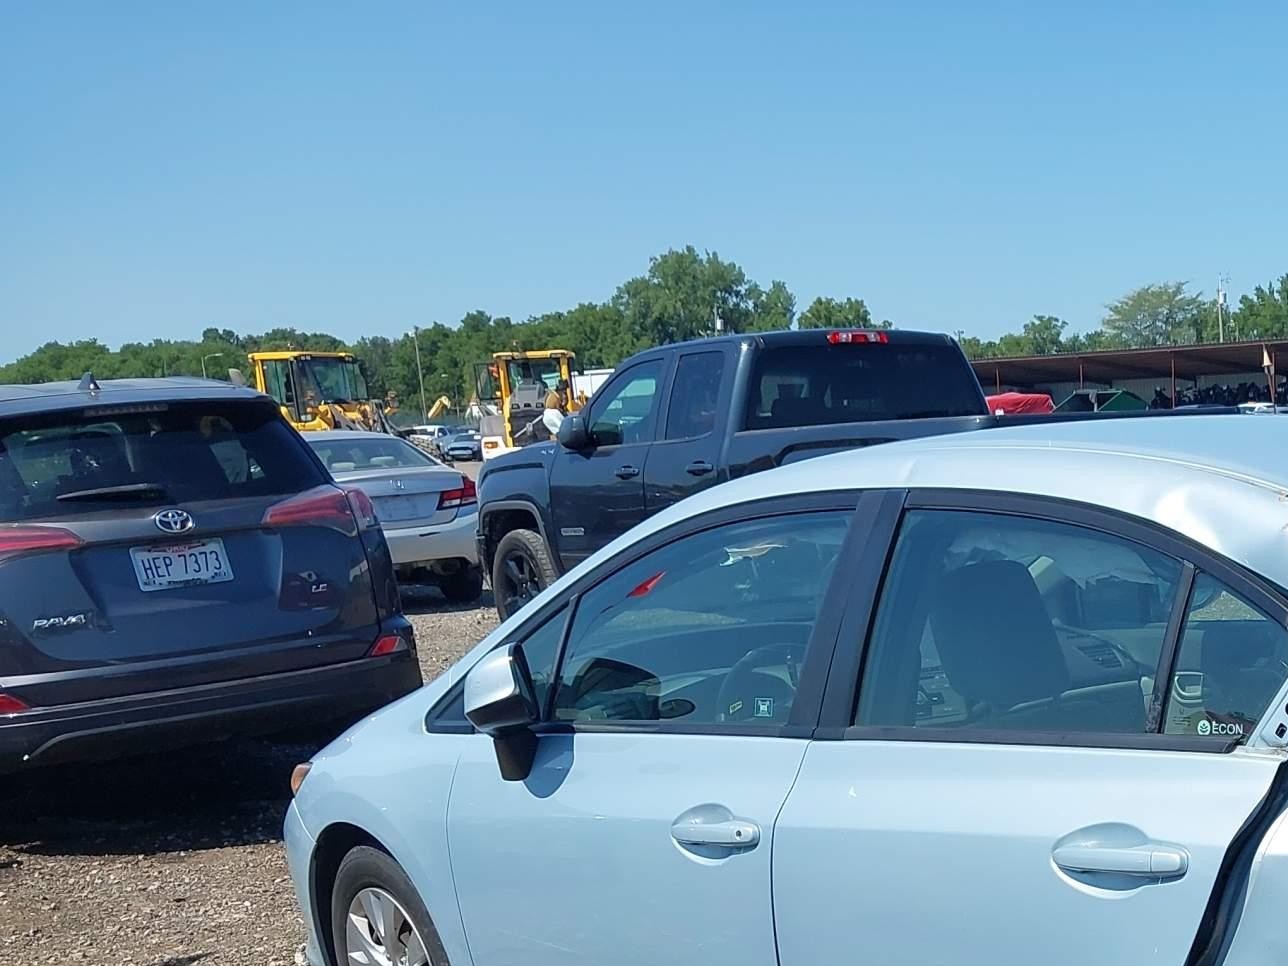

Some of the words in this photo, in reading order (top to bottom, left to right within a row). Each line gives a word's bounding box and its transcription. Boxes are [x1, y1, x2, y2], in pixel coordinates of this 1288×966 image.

[141, 556, 173, 580] HEP
[178, 550, 222, 575] 7373
[1211, 722, 1244, 735] ECON
